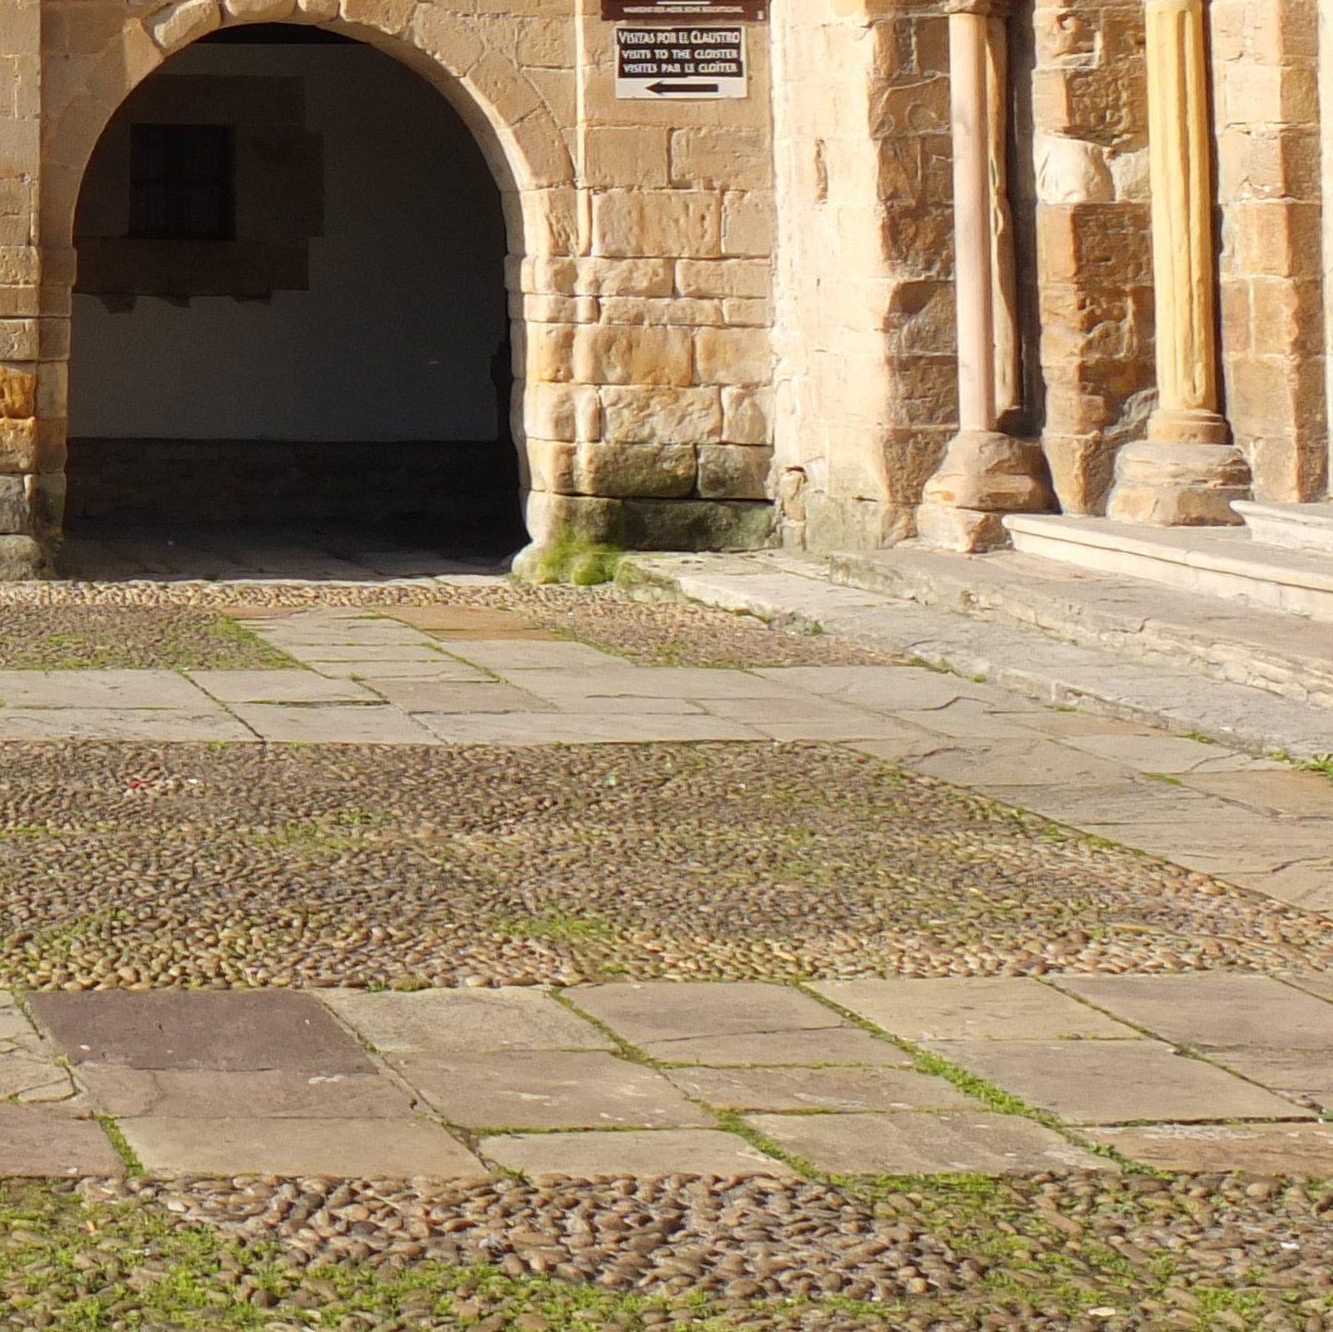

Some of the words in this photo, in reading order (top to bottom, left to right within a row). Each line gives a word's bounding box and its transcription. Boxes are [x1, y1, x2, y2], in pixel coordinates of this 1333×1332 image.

[656, 32, 677, 44] POR
[679, 32, 690, 44] EL
[654, 49, 669, 59] TO
[671, 49, 691, 59] THE
[661, 63, 681, 73] PAR
